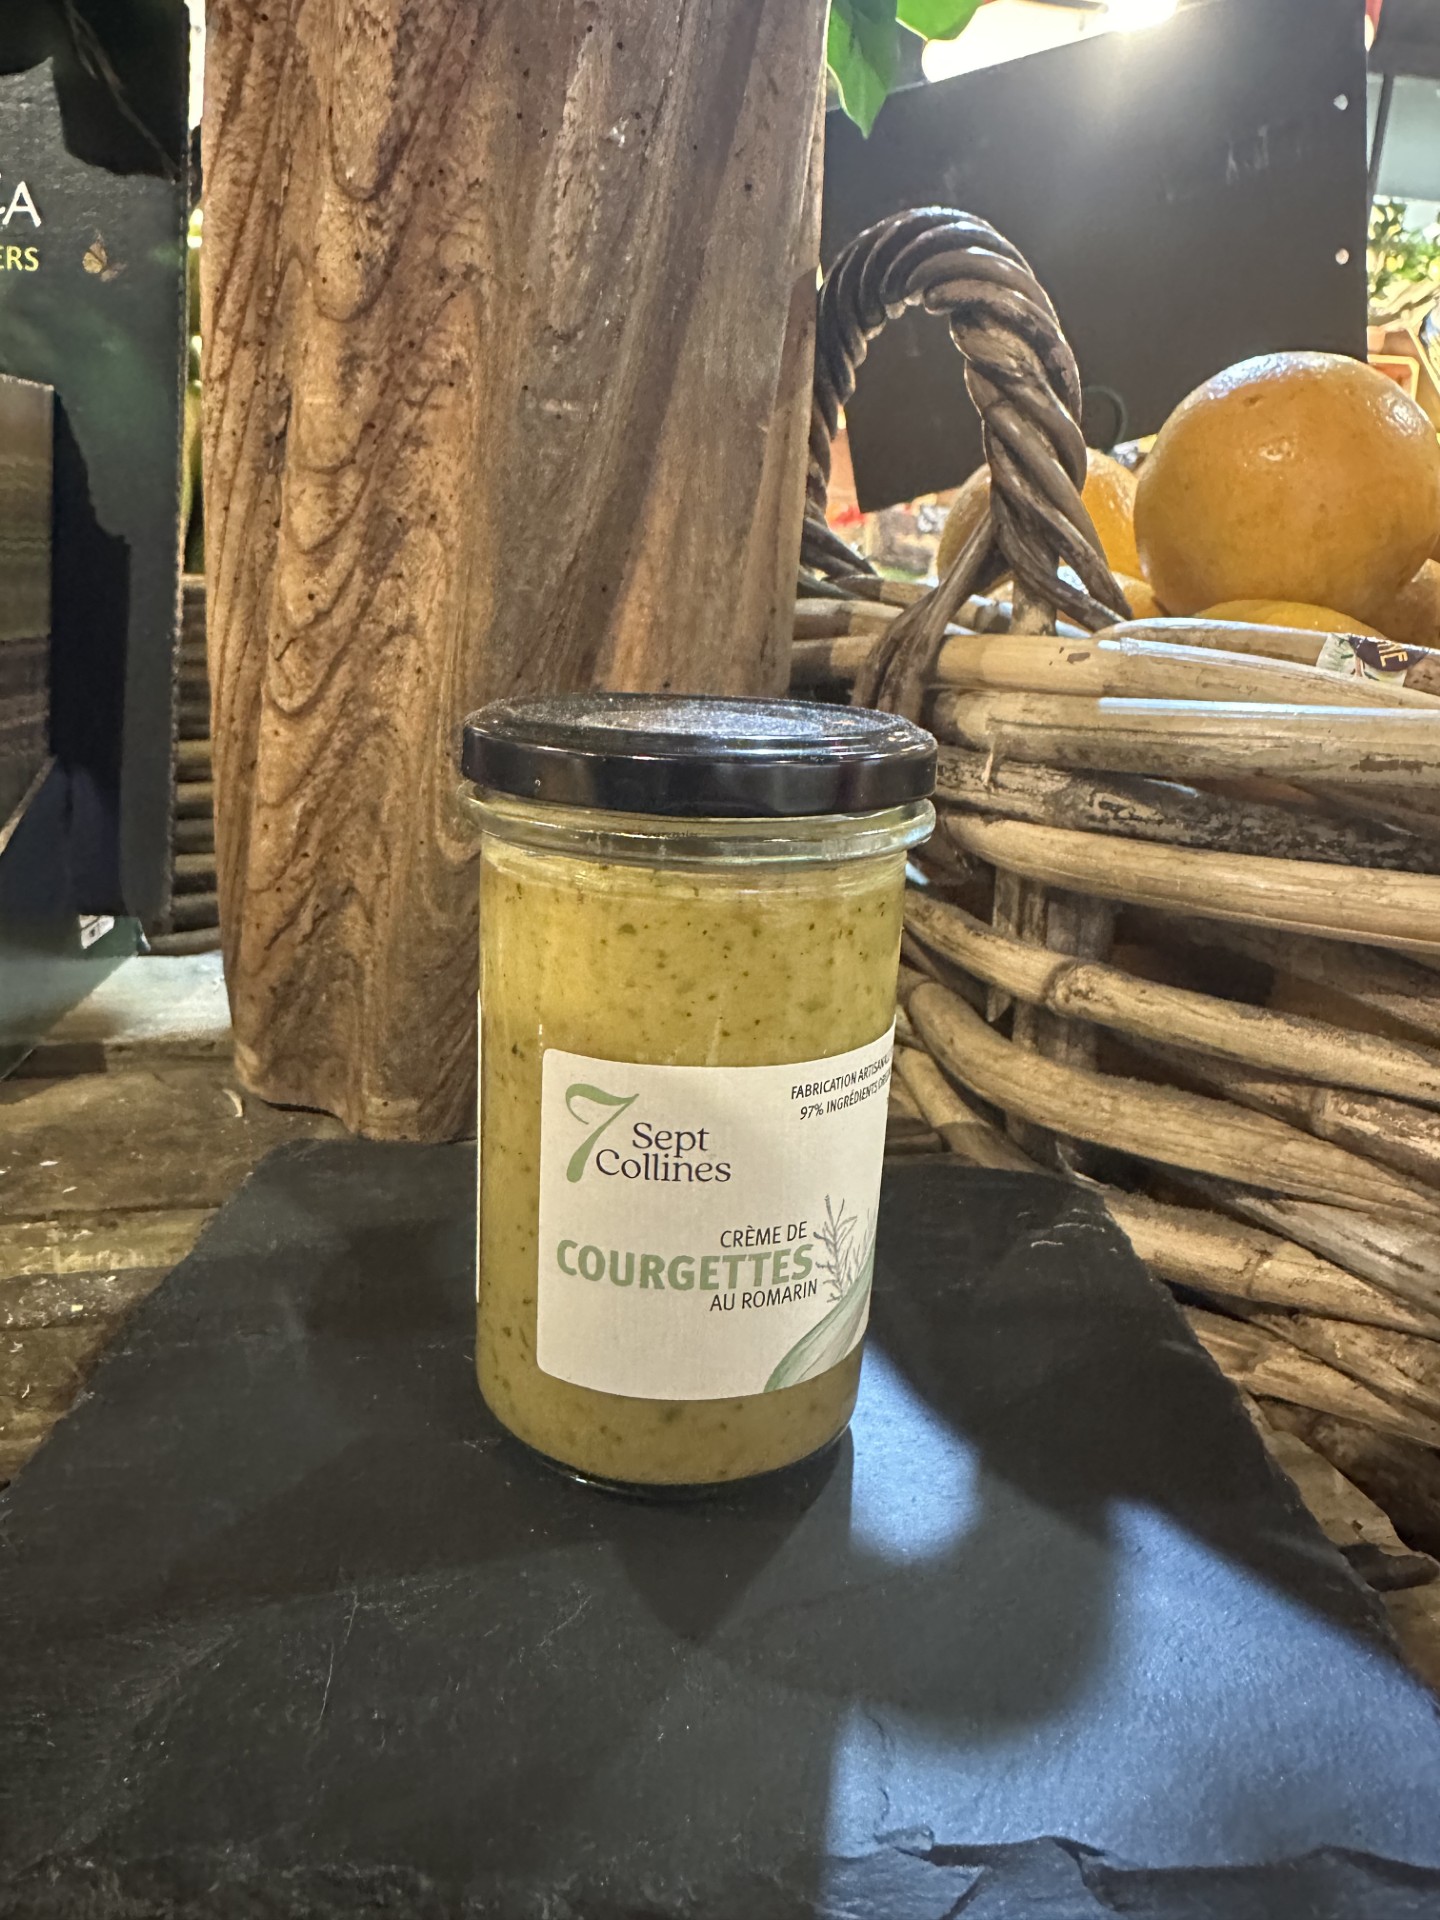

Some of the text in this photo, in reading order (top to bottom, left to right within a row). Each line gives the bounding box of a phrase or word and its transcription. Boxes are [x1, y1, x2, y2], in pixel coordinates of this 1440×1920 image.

[0, 172, 42, 228] A
[791, 1071, 858, 1100] FABRICATION
[800, 1080, 878, 1120] 97% INGRÉDIENTS
[565, 1083, 640, 1183] 7
[632, 1122, 710, 1158] Sept
[595, 1148, 732, 1182] Collines
[720, 1221, 808, 1248] CRÈME DE
[556, 1239, 814, 1291] COURGETTES
[709, 1278, 818, 1312] AU ROMARIN
